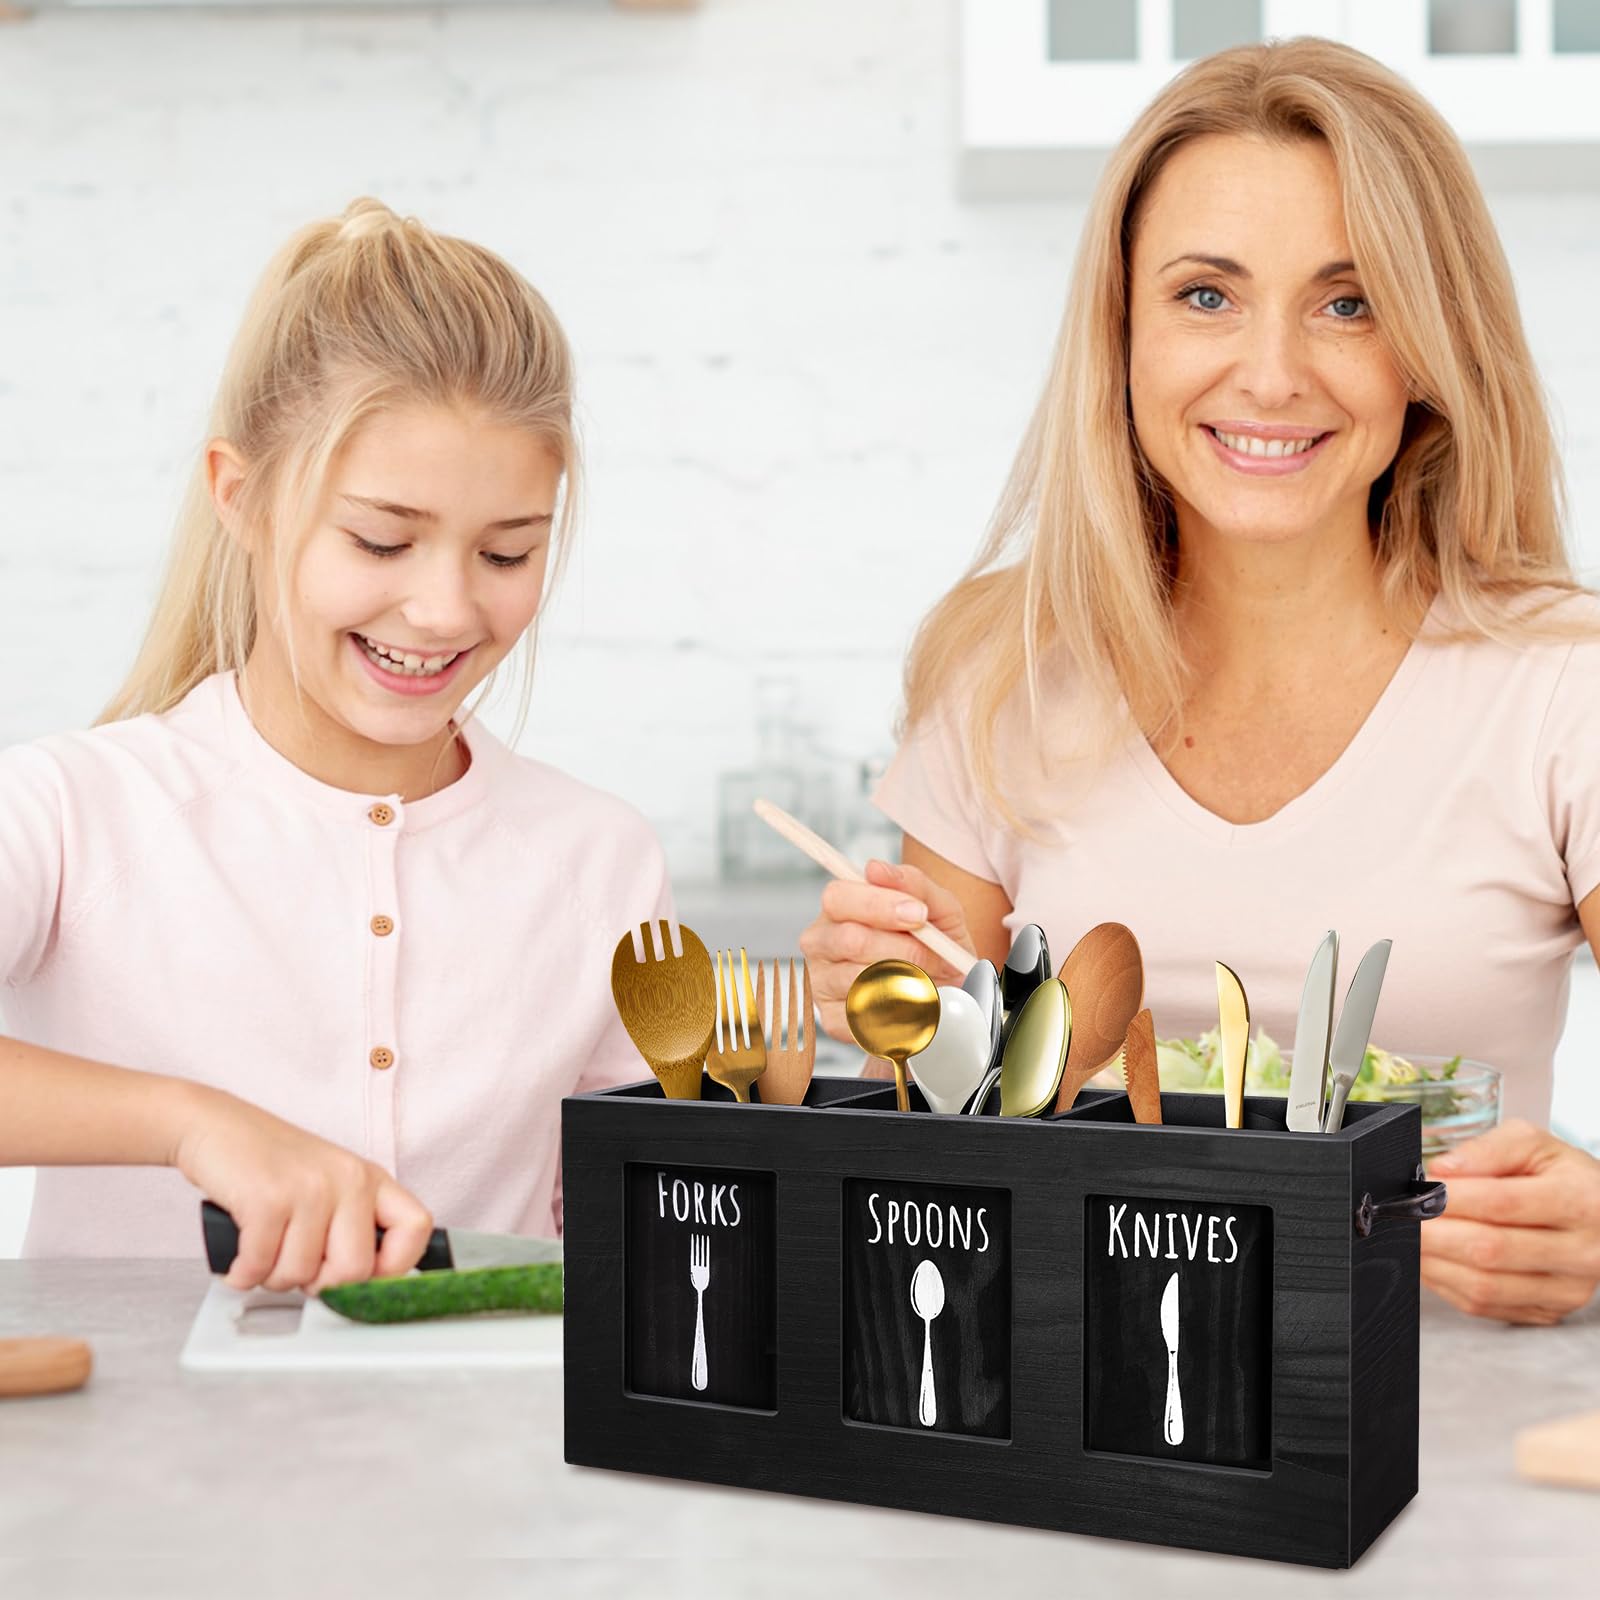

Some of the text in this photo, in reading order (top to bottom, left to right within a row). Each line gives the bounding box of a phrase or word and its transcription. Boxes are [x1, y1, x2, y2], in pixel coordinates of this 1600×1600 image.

[657, 1172, 741, 1227] FORKS
[867, 1193, 989, 1253] SPOONS
[1107, 1203, 1238, 1264] KNIVES
